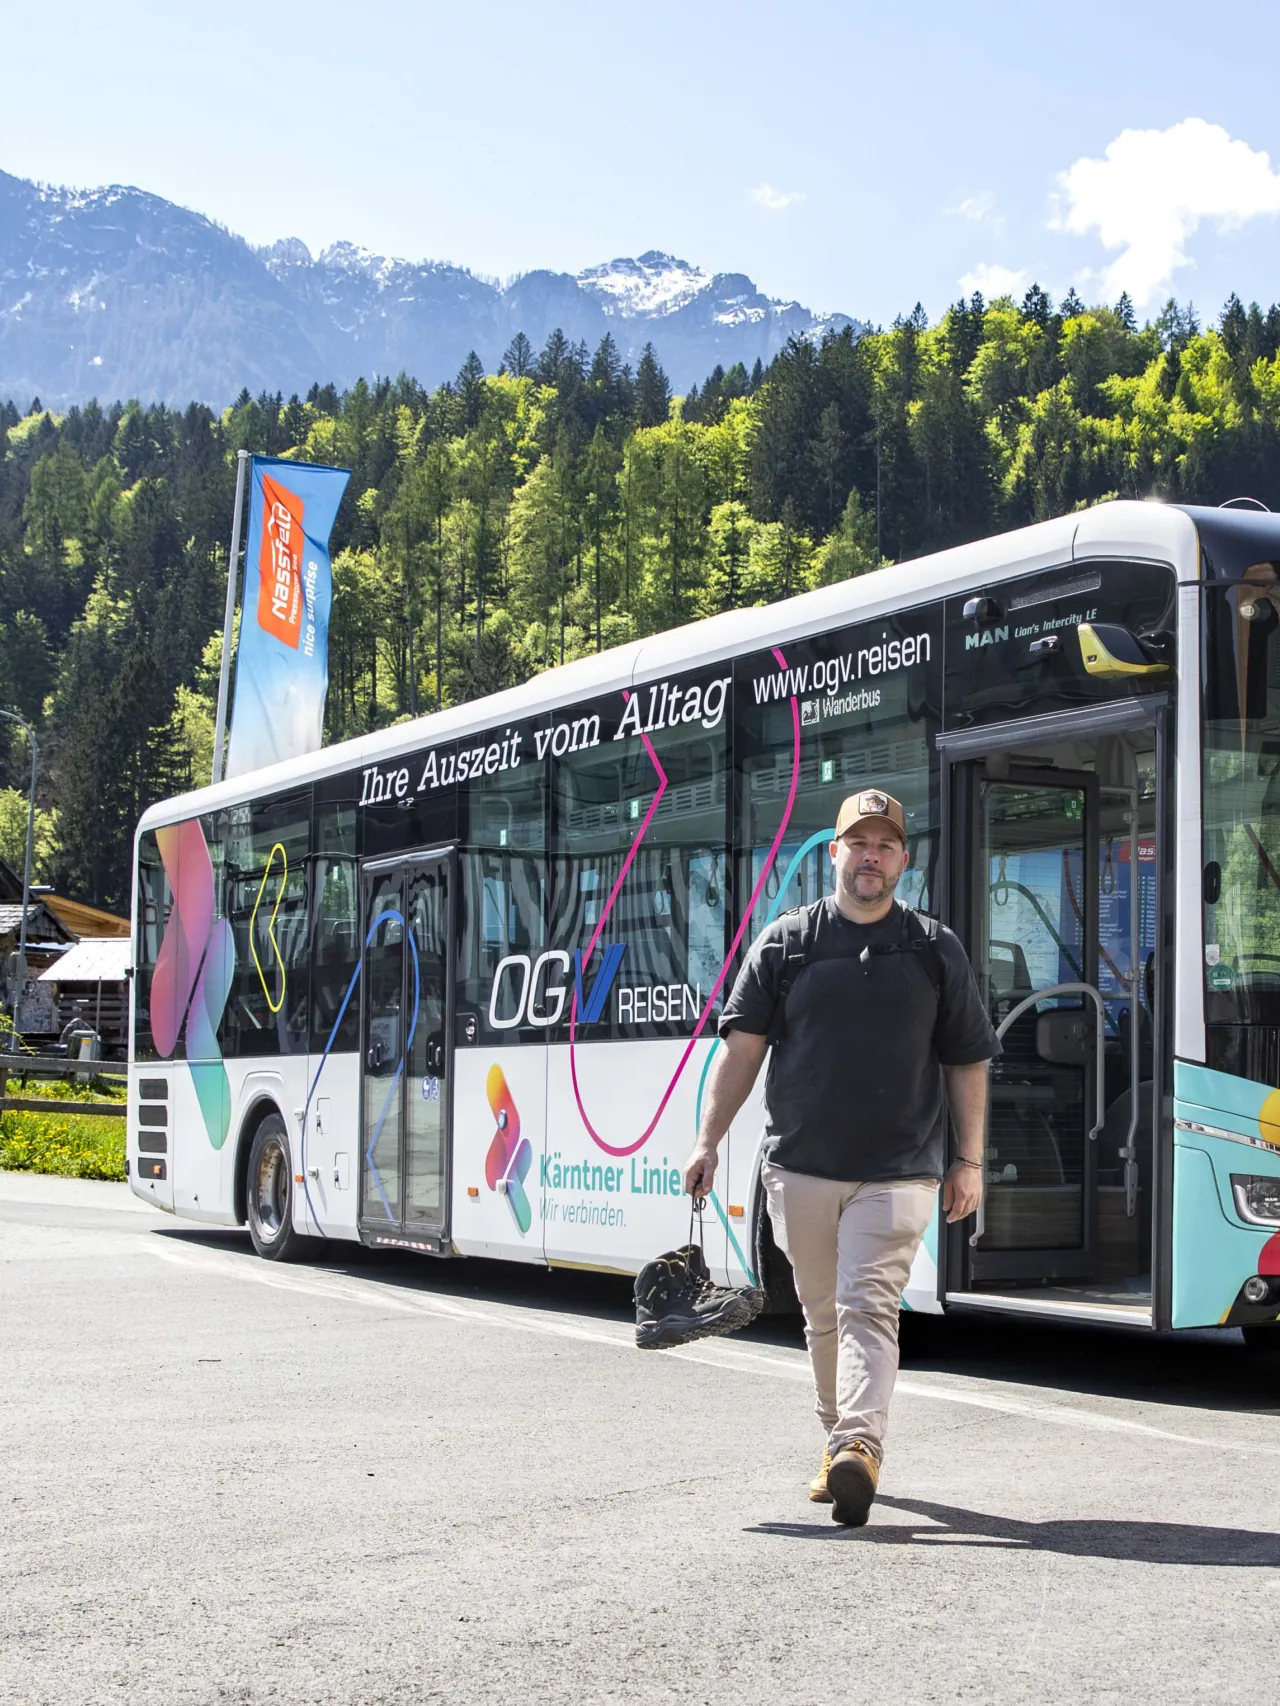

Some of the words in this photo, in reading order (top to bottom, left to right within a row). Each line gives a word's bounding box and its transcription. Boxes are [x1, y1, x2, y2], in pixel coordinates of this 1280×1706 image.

[272, 502, 292, 620] Nassfeld
[304, 561, 318, 622] surprise
[302, 625, 316, 657] nice
[965, 625, 1009, 650] MAN
[1014, 623, 1040, 638] Lion's
[1043, 613, 1082, 631] Intercity
[1085, 608, 1098, 620] LE
[753, 632, 931, 705] www.ogv.reisen
[822, 689, 881, 718] Wanderbus
[359, 766, 410, 807] Ihre
[417, 728, 522, 792] Auszeit
[534, 714, 600, 761] vom
[613, 676, 732, 741] Alltag
[488, 943, 629, 1029] OGV
[618, 983, 701, 1024] REISEN
[540, 1152, 624, 1192] Kärntner
[631, 1156, 687, 1197] Linie
[539, 1197, 559, 1222] Wir
[562, 1199, 627, 1228] verbinden.
